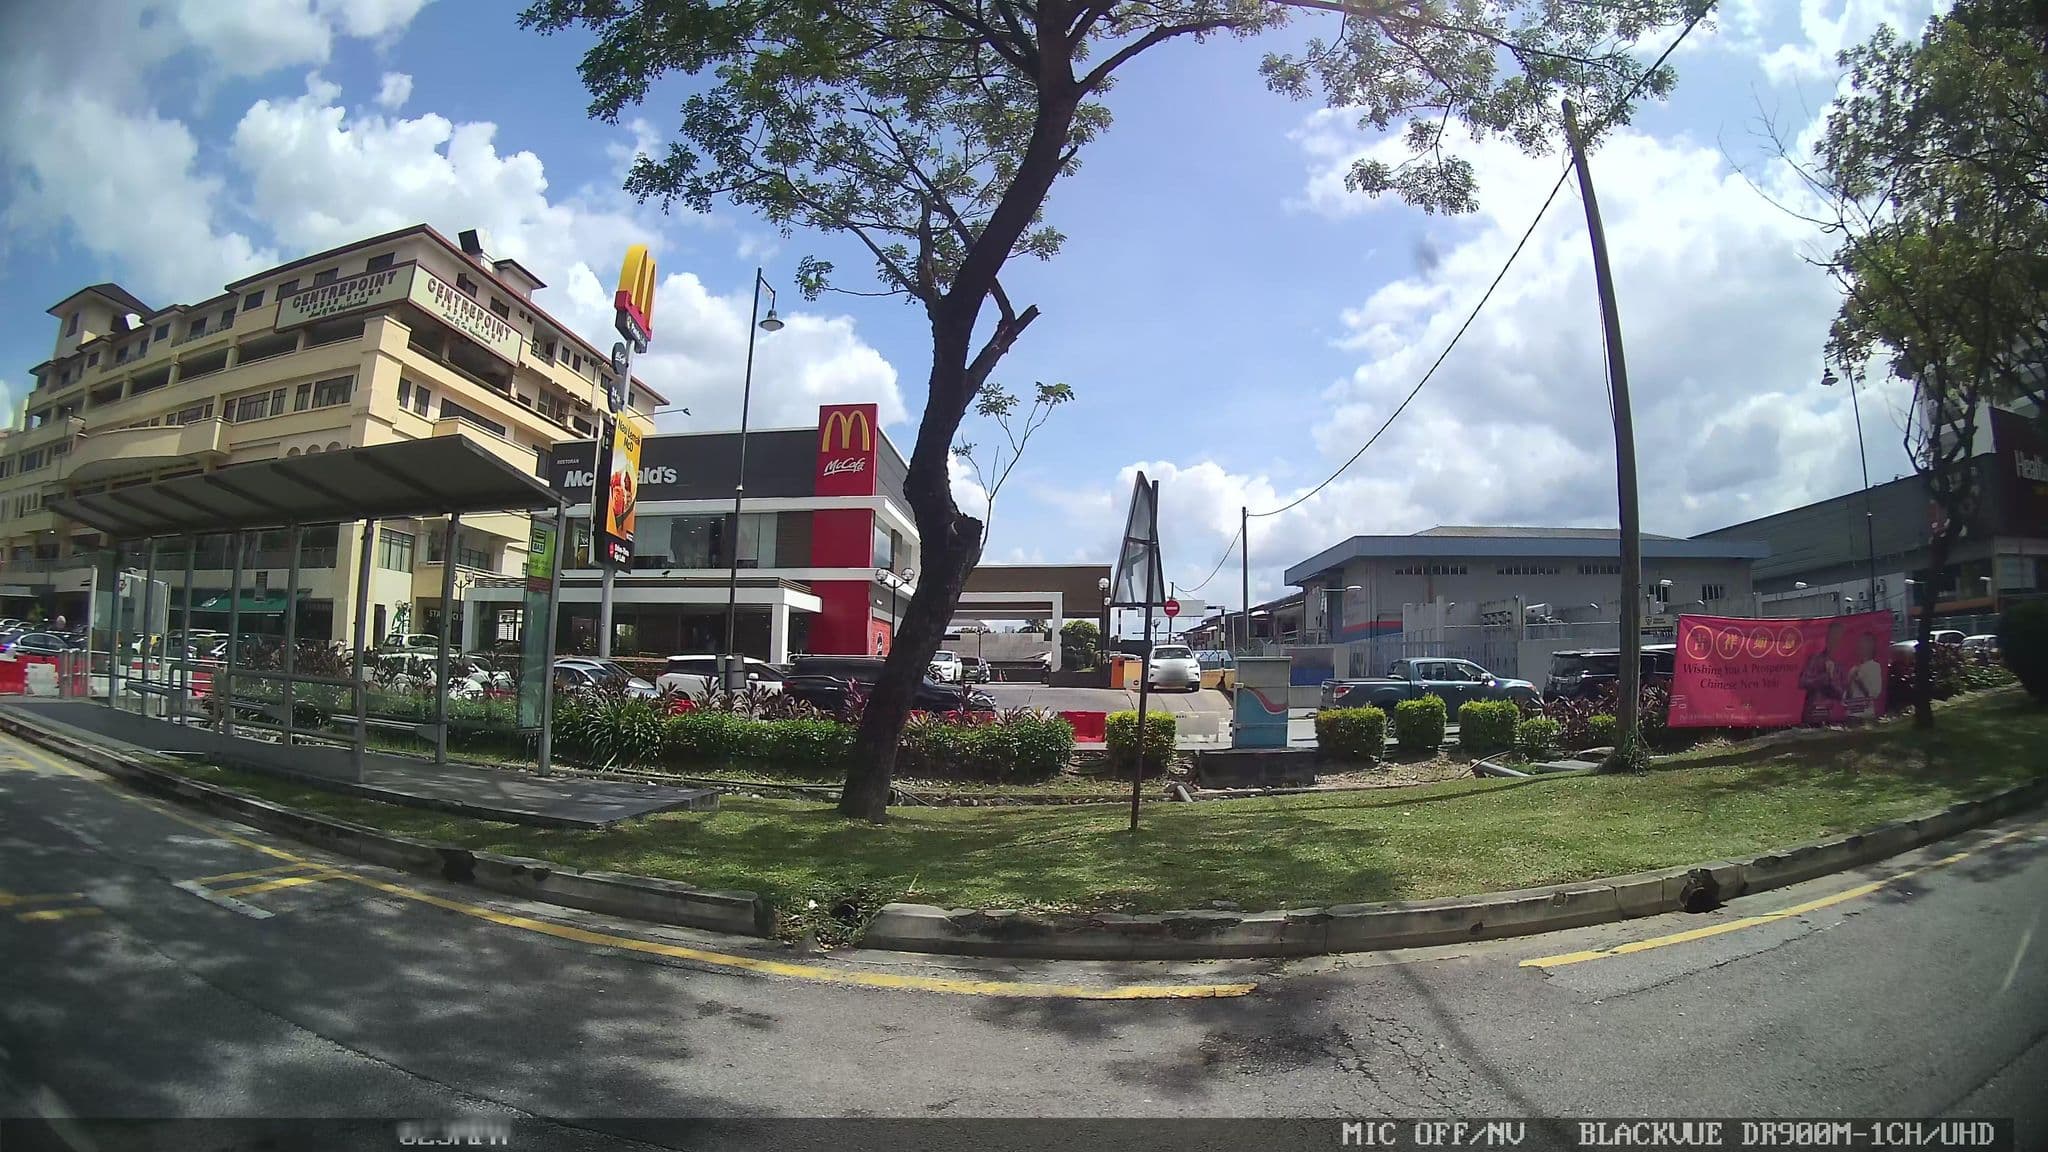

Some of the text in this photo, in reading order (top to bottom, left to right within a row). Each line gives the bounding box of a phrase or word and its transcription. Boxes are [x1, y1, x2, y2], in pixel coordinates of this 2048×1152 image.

[292, 270, 397, 308] CENTREPOINT
[299, 287, 381, 313] BANDAR UTAMA
[427, 278, 511, 340] CENTREPOINT
[564, 466, 678, 488] Mcald's
[1683, 663, 1721, 678] Wishing
[1724, 664, 1740, 675] You
[1700, 678, 1780, 690] Chinese New Year
